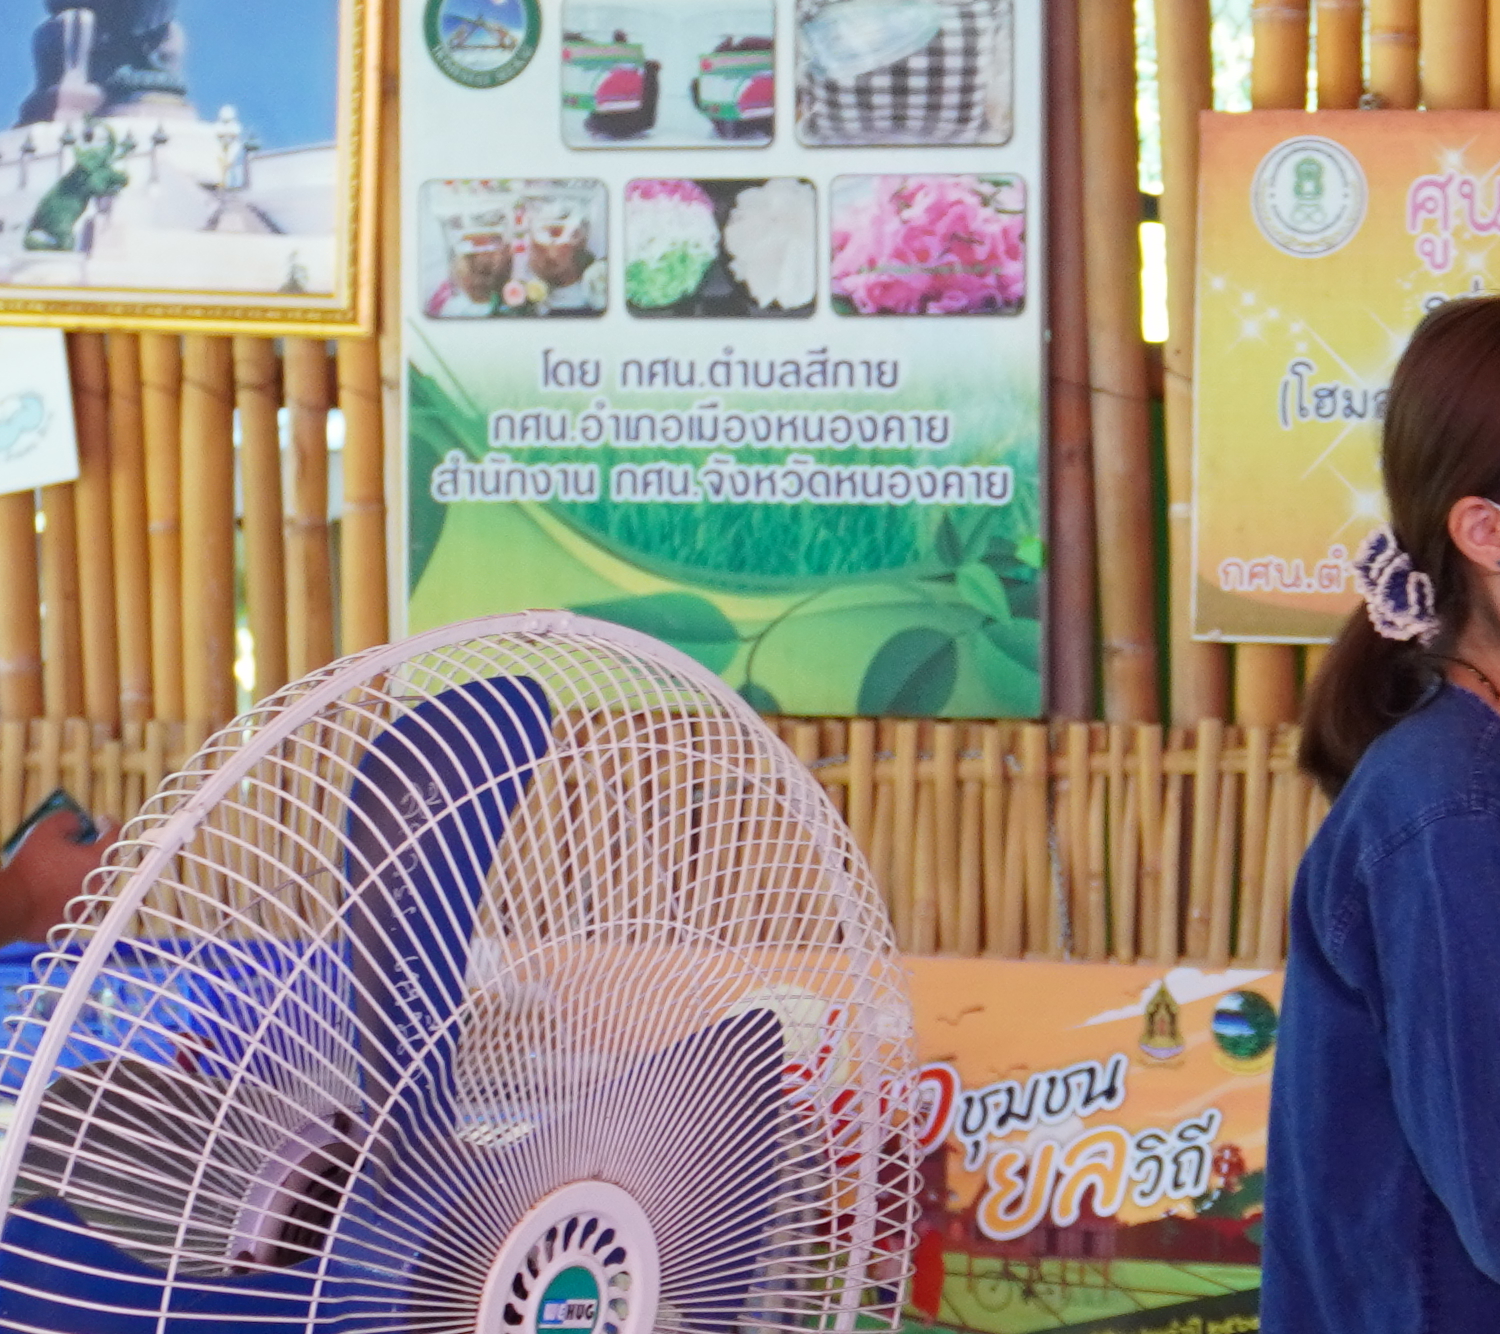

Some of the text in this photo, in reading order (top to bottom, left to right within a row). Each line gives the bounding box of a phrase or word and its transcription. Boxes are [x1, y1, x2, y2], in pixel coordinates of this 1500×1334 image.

[541, 349, 900, 390] โดย กศน.ตำบลสีกาย
[491, 401, 951, 445] กศน.อำเภอเมืองหนองคาย
[436, 457, 1013, 501] สำนักงาน กศน.จังหวัดหนองคาย
